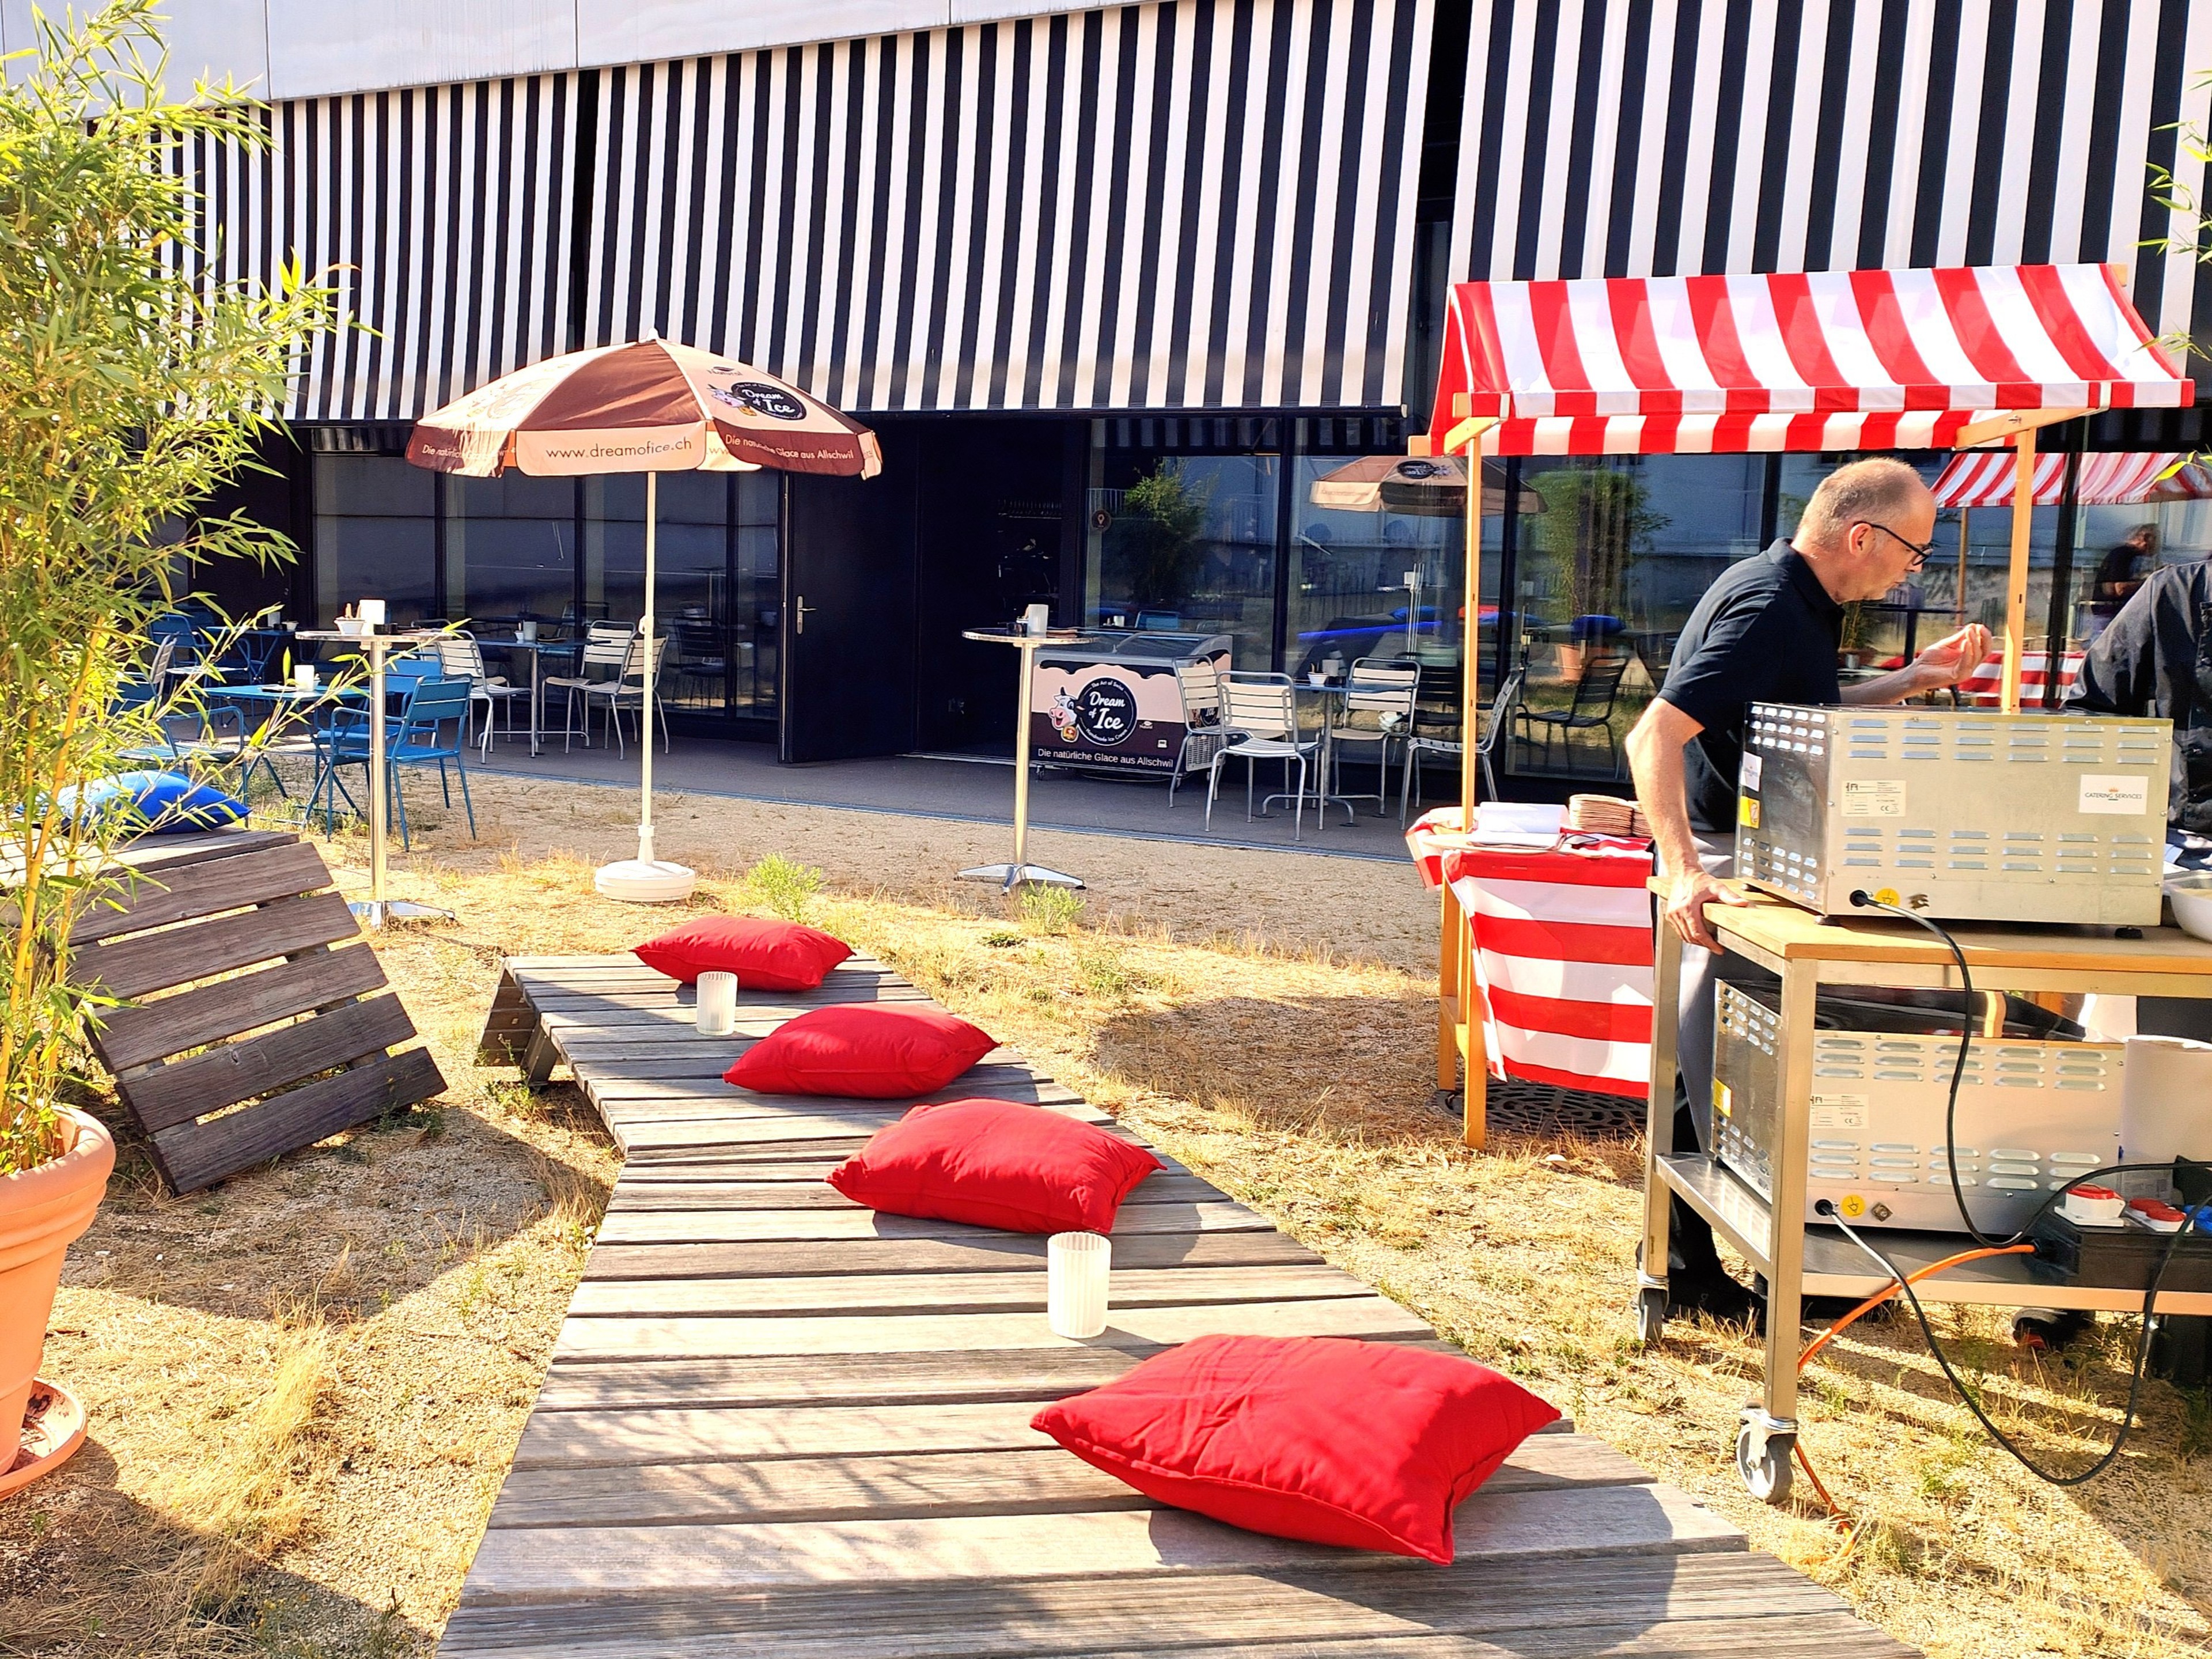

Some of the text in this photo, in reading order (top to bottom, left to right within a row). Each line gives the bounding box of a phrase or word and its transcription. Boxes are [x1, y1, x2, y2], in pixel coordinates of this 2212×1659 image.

[742, 389, 783, 400] Dream
[762, 399, 795, 412] Ice
[422, 444, 435, 455] Die
[546, 437, 692, 458] www.dreamofice.ch
[725, 434, 741, 445] Die
[776, 448, 799, 458] Glace
[817, 449, 854, 460] Allschwil
[1089, 691, 1126, 707] Dream
[1089, 708, 1124, 729] of Ice
[1038, 749, 1051, 757] Die
[1053, 751, 1092, 761] natürliche
[1094, 753, 1119, 763] Glace
[1137, 756, 1173, 768] Allschwil
